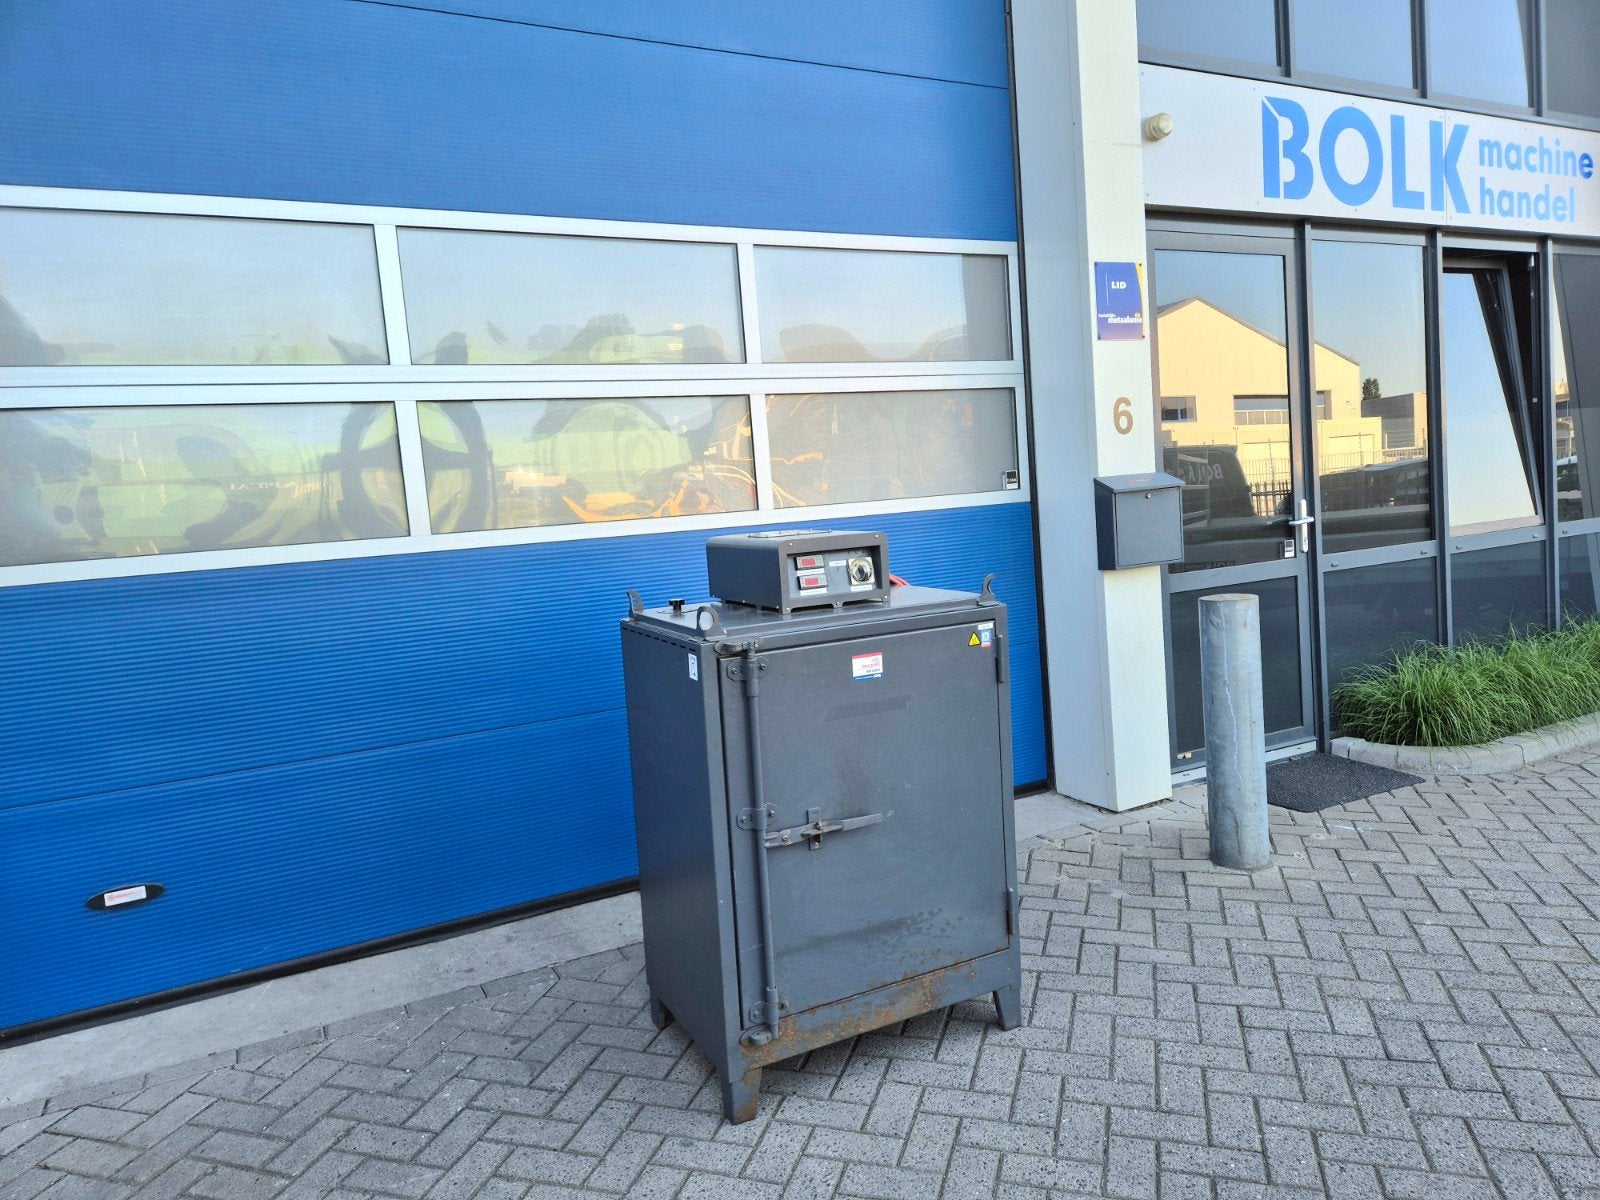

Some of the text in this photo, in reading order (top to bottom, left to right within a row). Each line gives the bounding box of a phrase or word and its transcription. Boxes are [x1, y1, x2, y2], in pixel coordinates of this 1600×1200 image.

[1261, 95, 1471, 214] BOLK
[1479, 136, 1594, 179] machine
[1479, 176, 1576, 223] handel
[1111, 281, 1127, 289] LID
[1113, 396, 1134, 435] 6
